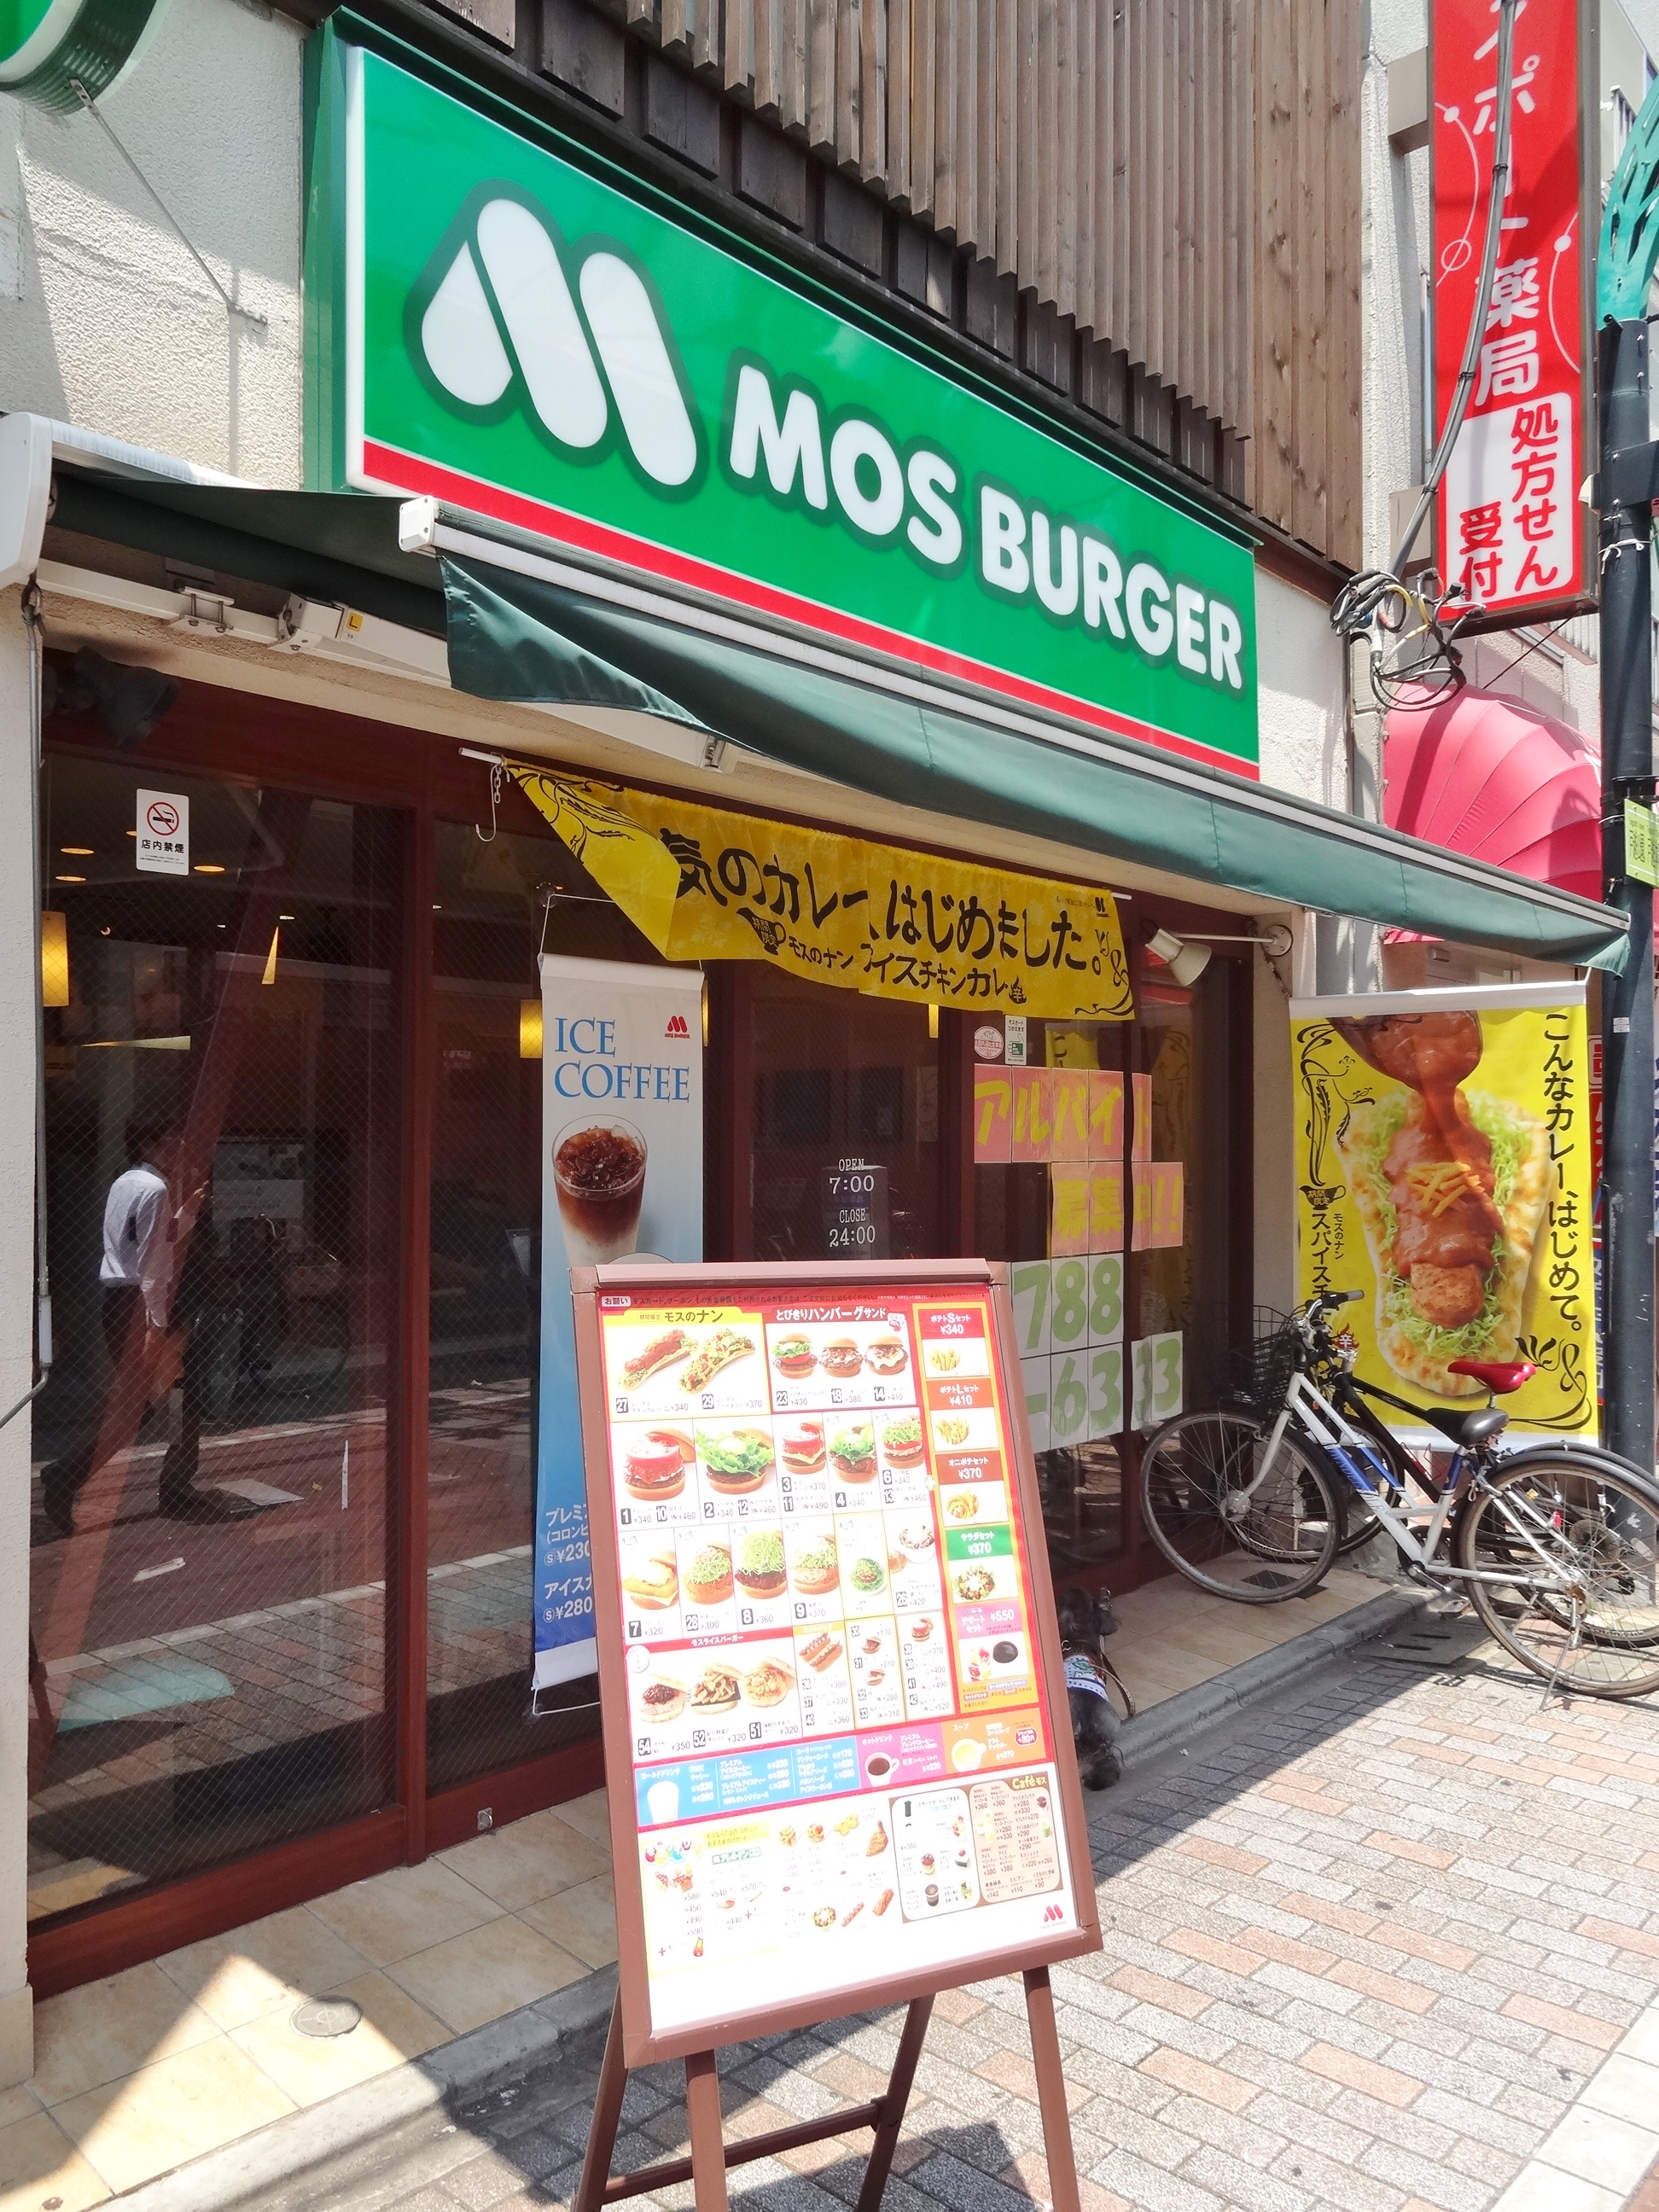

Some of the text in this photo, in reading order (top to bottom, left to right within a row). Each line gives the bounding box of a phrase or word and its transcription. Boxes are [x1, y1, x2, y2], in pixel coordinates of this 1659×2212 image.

[1511, 407, 1559, 590] 処方せん
[729, 364, 1243, 690] MOS BURGER
[1458, 500, 1504, 599] 受付
[141, 839, 184, 853] 店内禁煙
[788, 934, 854, 969] モスのナン
[554, 1016, 617, 1058] ICE
[553, 1060, 690, 1103] COFFEE
[974, 1079, 1150, 1147] アルバイト
[838, 1158, 865, 1172] OPEN
[1542, 1012, 1583, 1333] こんなカレー、はじめて。
[828, 1174, 876, 1195] 7:00
[839, 1208, 867, 1223] CLOSE
[828, 1225, 876, 1248] 24:00
[1333, 1213, 1345, 1260] モスのナン
[603, 1296, 630, 1306] お願い
[1013, 1257, 1124, 1351] 788
[664, 1309, 724, 1324] モスのナン
[775, 1305, 887, 1322] とびきりハンバーグサンド
[940, 1323, 964, 1336] ¥340
[948, 1394, 973, 1406] ¥410
[958, 1466, 983, 1480] ¥370
[545, 1502, 588, 1528] プレミ
[620, 1507, 632, 1525] 1
[704, 1502, 715, 1518] 2
[967, 1541, 992, 1555] ¥370
[742, 1609, 754, 1625] 8
[795, 1603, 807, 1620] 9
[990, 1608, 1015, 1622] ¥550
[629, 1621, 643, 1638] 7
[778, 1725, 799, 1735] ¥320
[952, 1722, 970, 1732] スープ
[671, 1740, 691, 1751] ¥350
[726, 1732, 747, 1743] ¥320
[1012, 1774, 1047, 1790] Café モス
